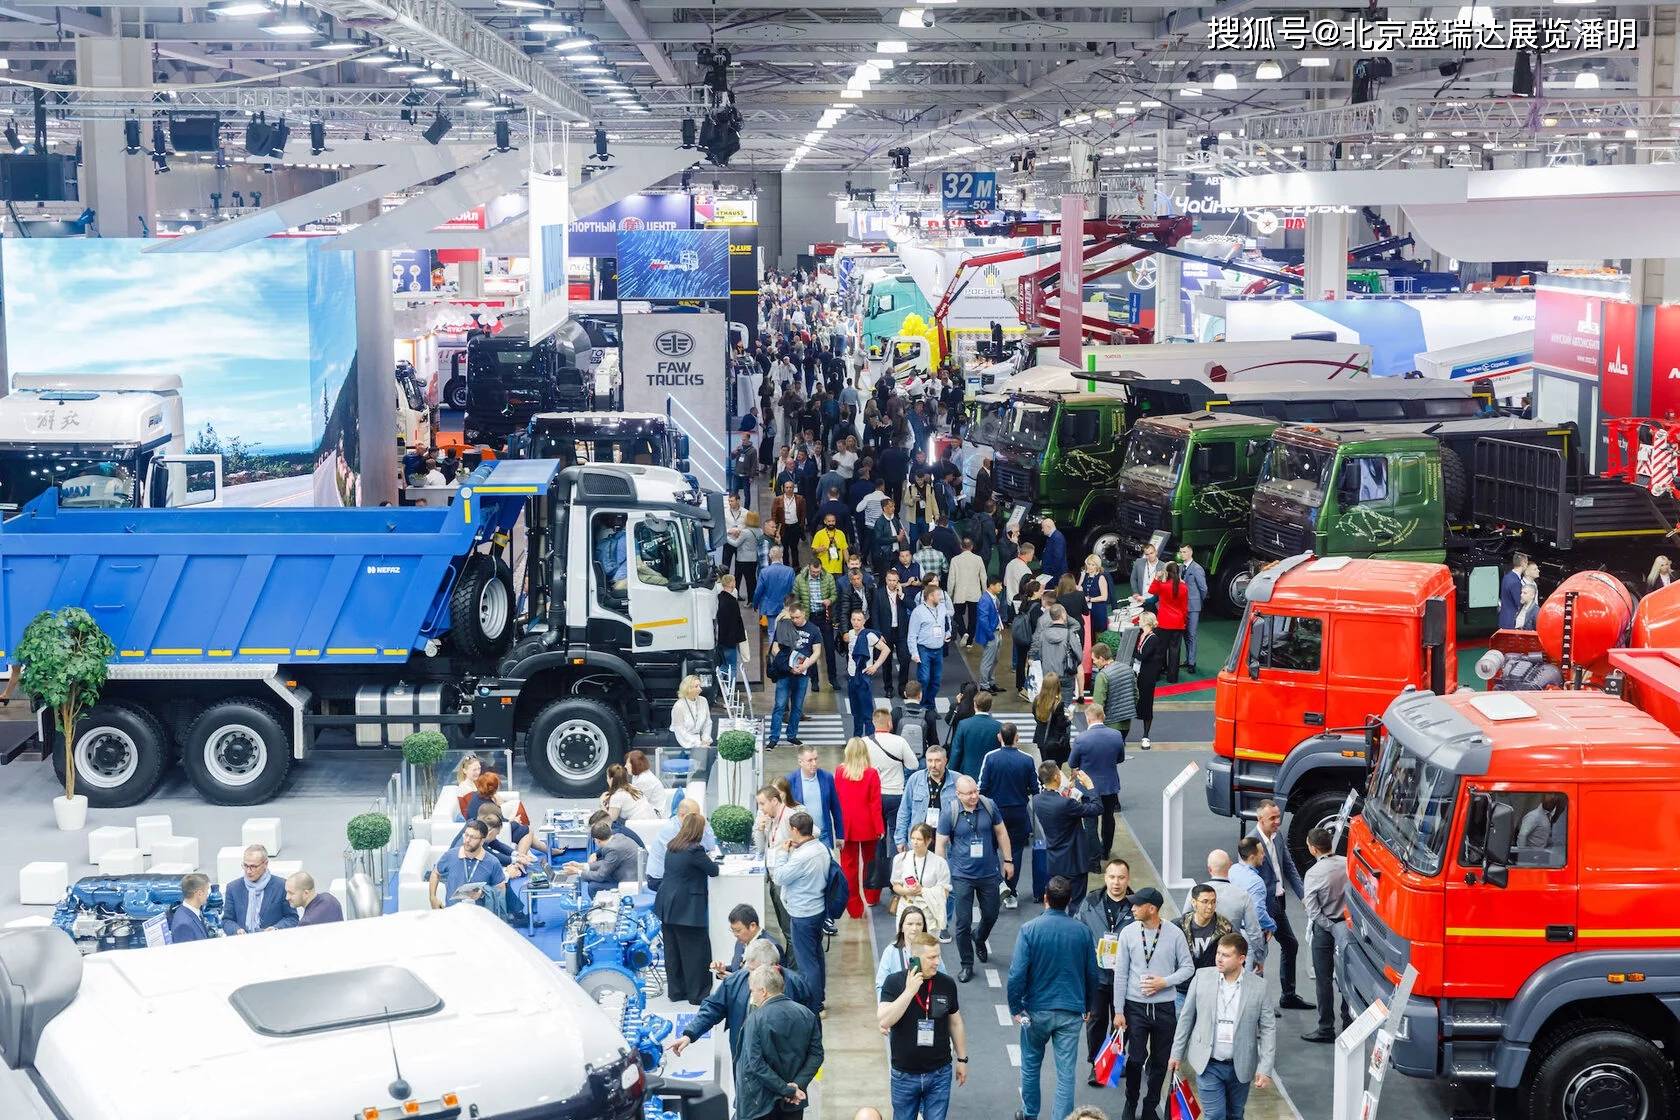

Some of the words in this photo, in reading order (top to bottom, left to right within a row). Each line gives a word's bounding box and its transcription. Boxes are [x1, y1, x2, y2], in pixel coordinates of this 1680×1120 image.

[943, 173, 973, 199] 32
[646, 221, 677, 231] ЦЕНТР
[657, 361, 691, 373] FAW
[646, 374, 704, 386] TRUCKS
[377, 566, 400, 574] NEFAZ
